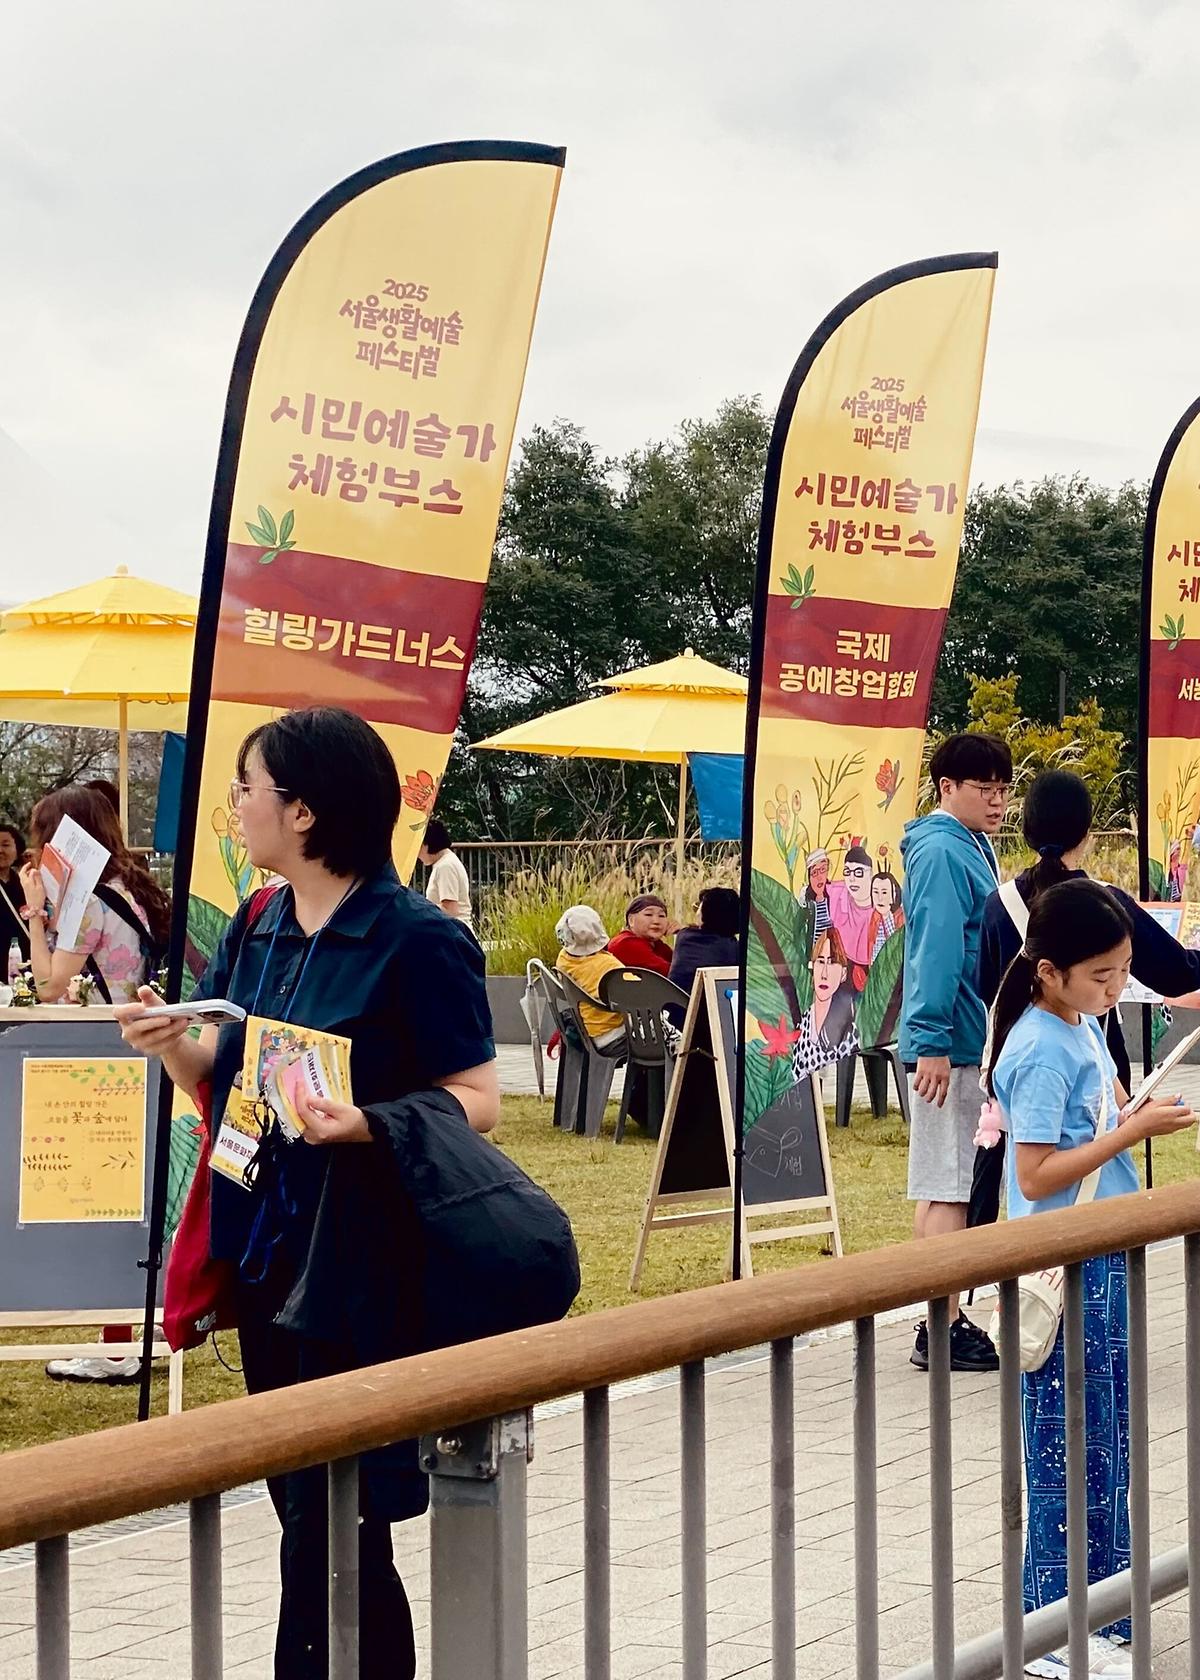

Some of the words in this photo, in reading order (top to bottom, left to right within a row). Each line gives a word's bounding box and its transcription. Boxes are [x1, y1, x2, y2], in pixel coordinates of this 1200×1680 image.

[382, 279, 429, 302] 2025
[339, 294, 464, 345] 서울생활예술
[355, 340, 440, 380] 페스티벌
[870, 377, 905, 394] 2025
[270, 392, 497, 462] 시민예술가
[840, 390, 927, 424] 서울생활예술
[853, 425, 912, 453] 페스티벌
[288, 453, 463, 515] 체험부스
[794, 472, 958, 515] 시민예술가
[808, 519, 936, 559] 체험부스
[243, 607, 467, 671] 힐링가드너스
[836, 630, 891, 663] 국제
[779, 663, 919, 701] 공예창업협회
